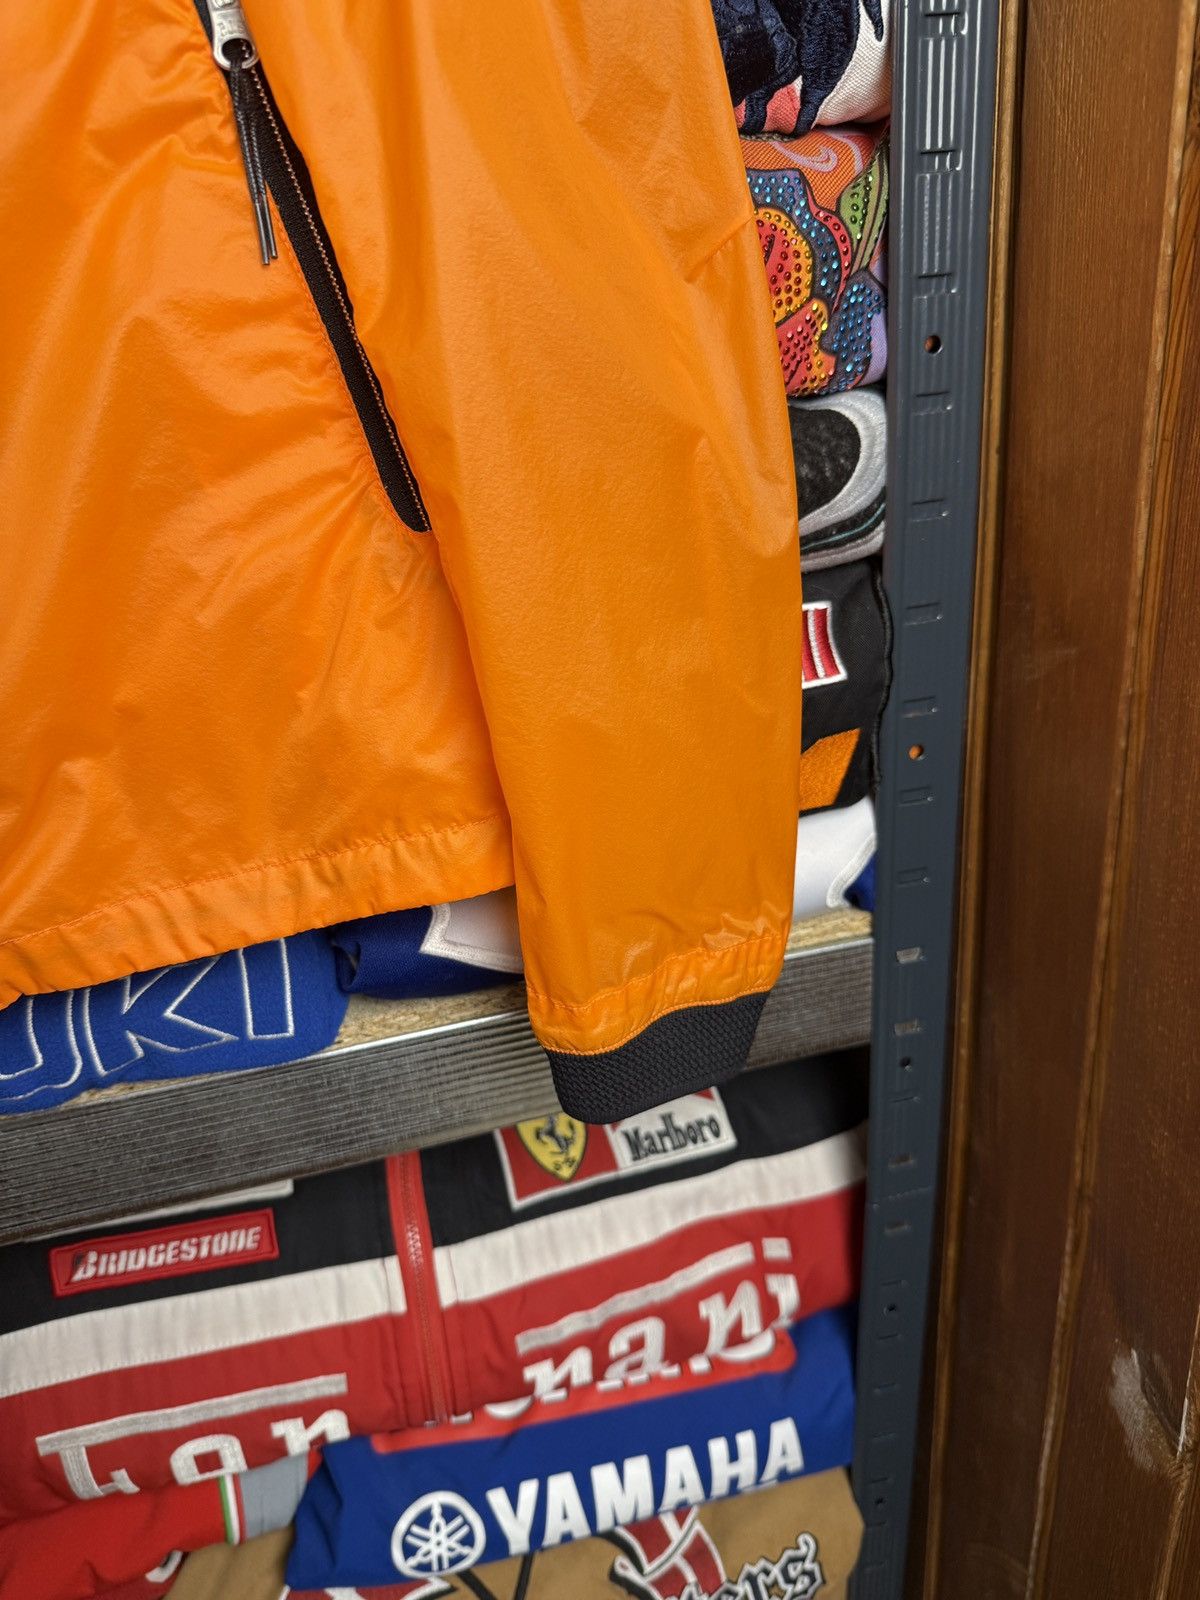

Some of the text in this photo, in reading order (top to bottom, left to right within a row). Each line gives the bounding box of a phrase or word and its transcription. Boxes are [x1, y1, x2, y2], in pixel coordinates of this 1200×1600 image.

[623, 1111, 722, 1162] Marlboro
[70, 1226, 262, 1283] BRIDGESTONE
[485, 1417, 805, 1557] YAMAHA
